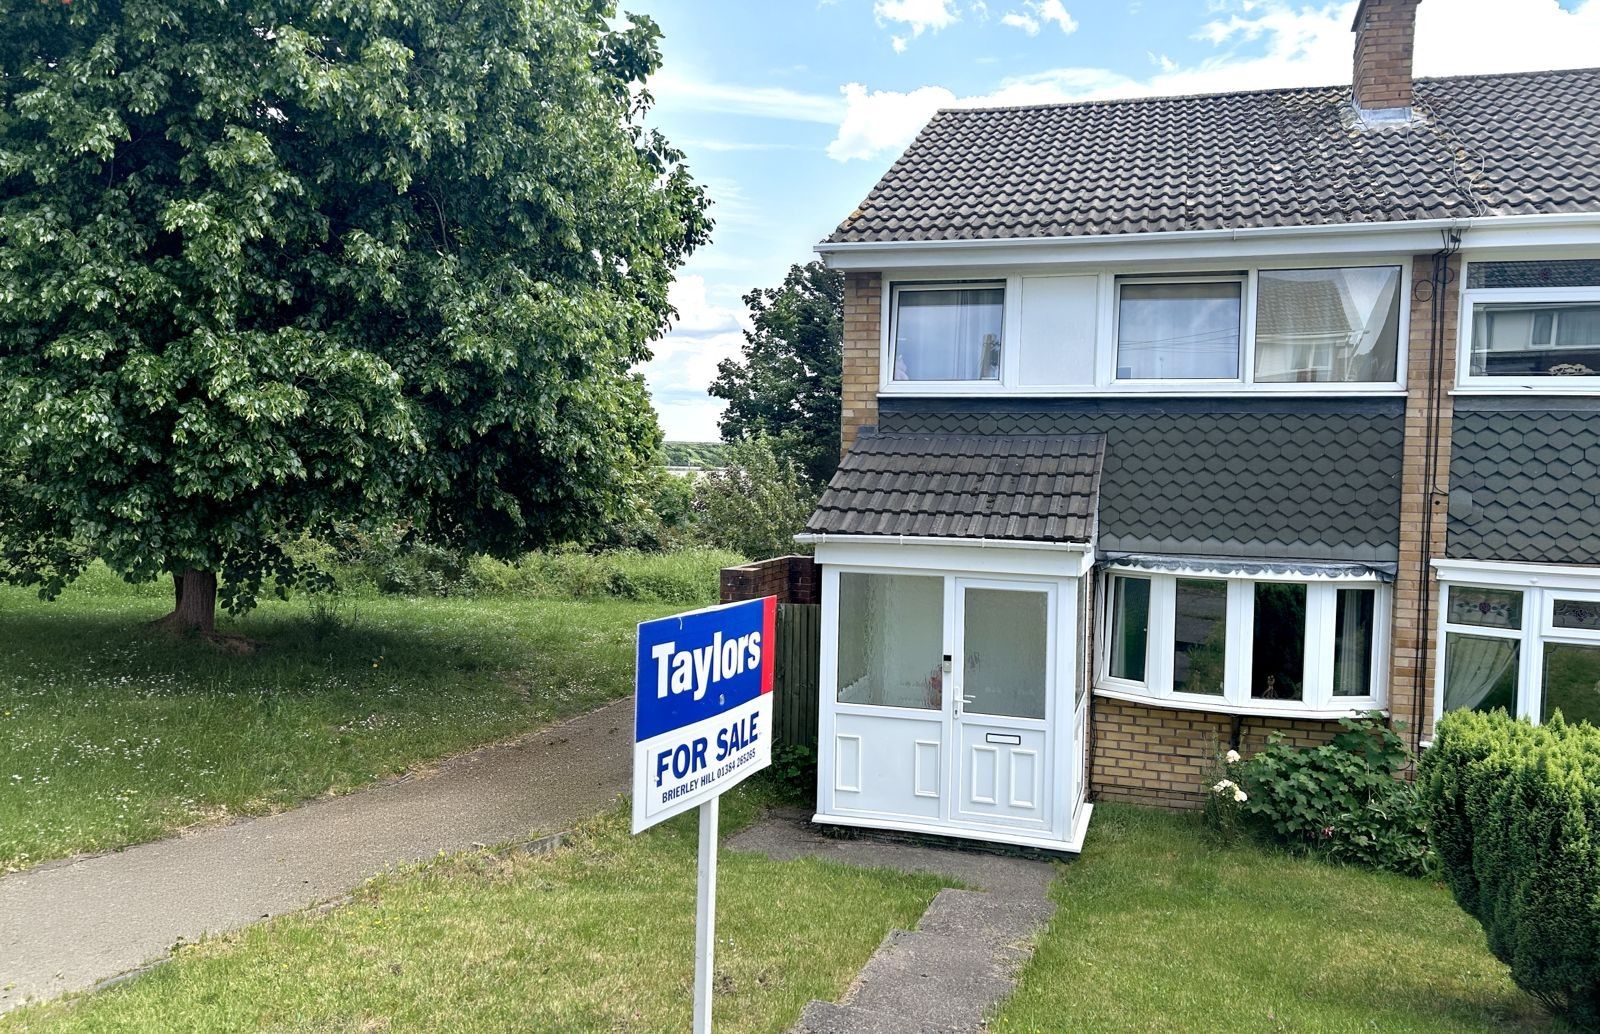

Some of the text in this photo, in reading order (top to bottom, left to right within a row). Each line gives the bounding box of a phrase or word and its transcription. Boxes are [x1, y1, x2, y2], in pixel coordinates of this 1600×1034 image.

[652, 631, 761, 701] Taylors
[656, 711, 759, 788] FOR SALE
[662, 747, 756, 804] BRIERLEY HILL 01384 265265
